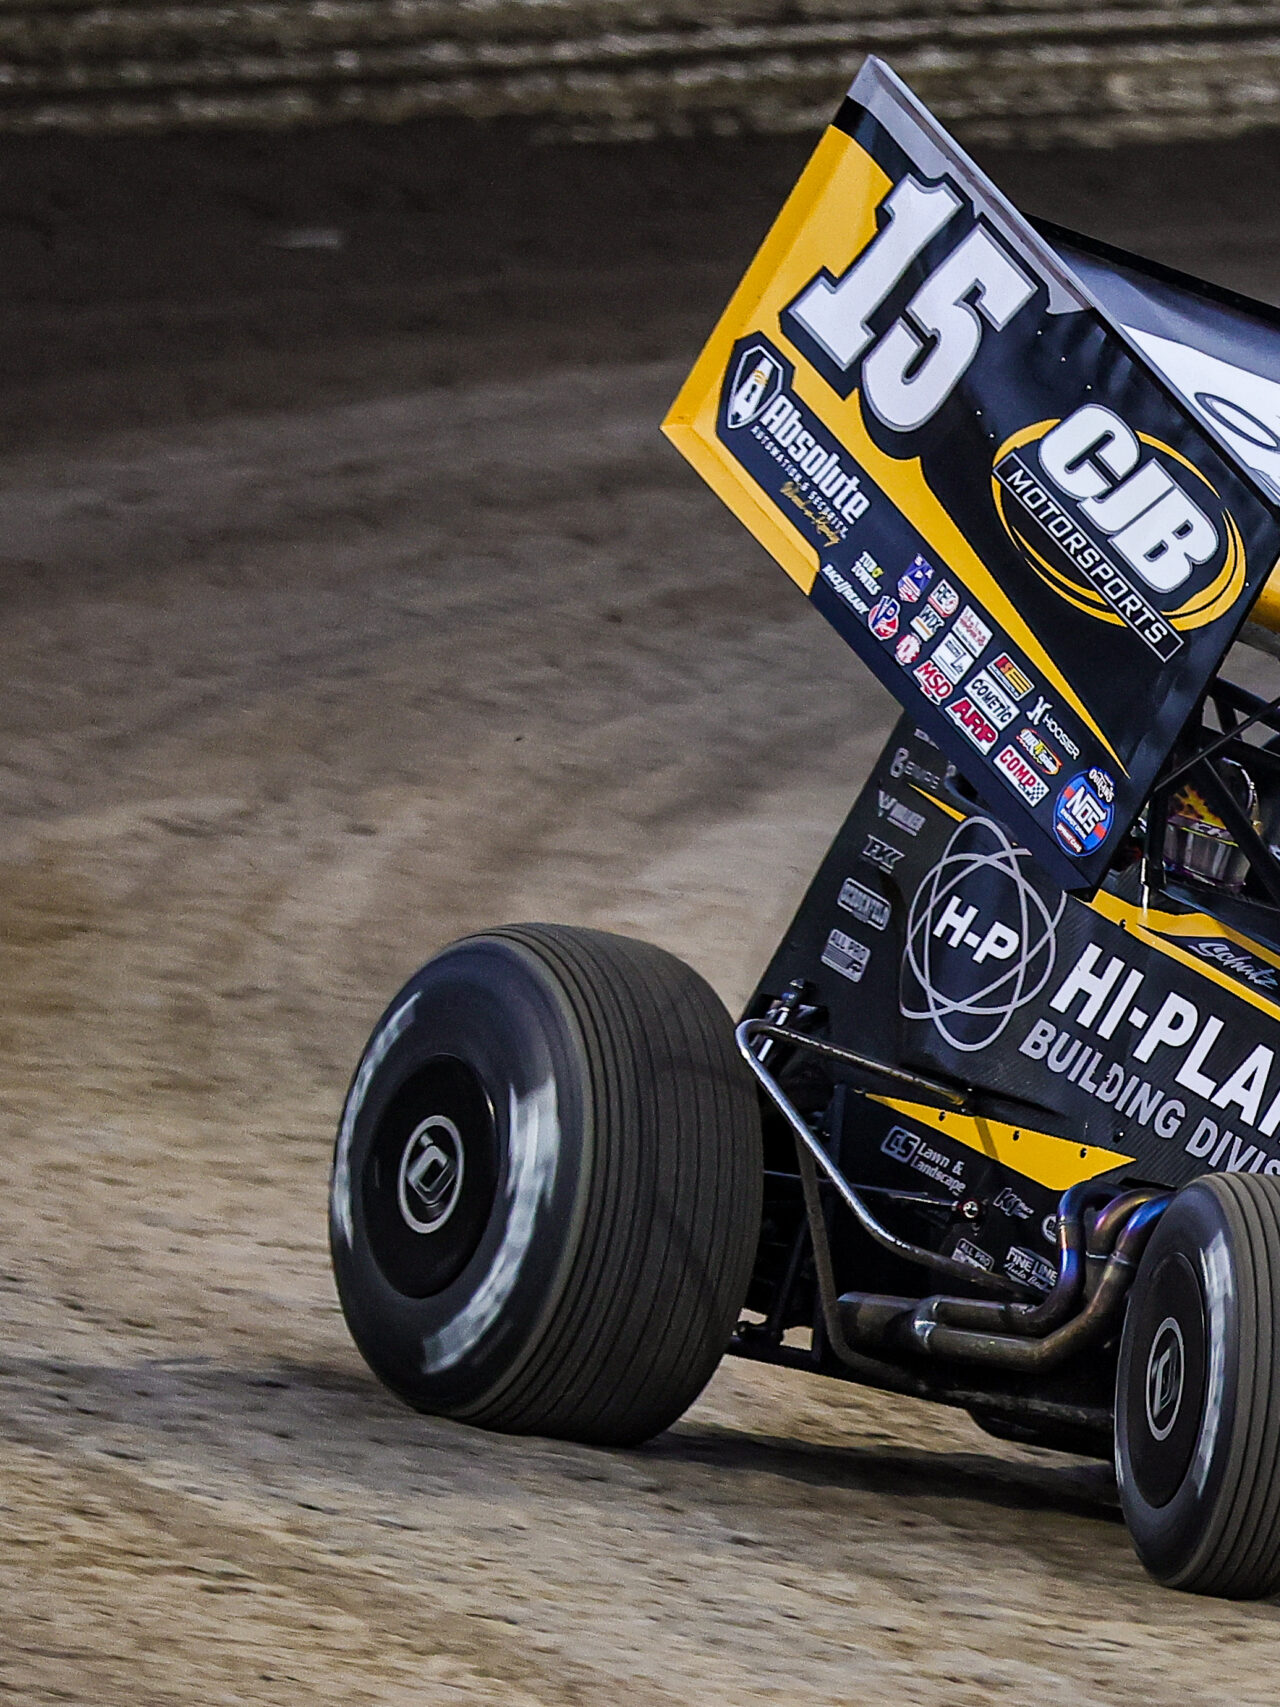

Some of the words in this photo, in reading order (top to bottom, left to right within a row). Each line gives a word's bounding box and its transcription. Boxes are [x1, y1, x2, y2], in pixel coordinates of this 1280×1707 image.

[787, 172, 1040, 433] 15
[759, 394, 871, 525] Absolute
[1036, 403, 1220, 594] CJB
[1005, 468, 1168, 644] MOTORSPORTS
[918, 606, 945, 632] WIX
[916, 660, 952, 701] MSD
[971, 677, 1013, 724] COMETIC
[951, 699, 998, 746] ARP
[1043, 713, 1080, 760] HOOSIER
[999, 749, 1036, 789] COMP
[1065, 788, 1107, 836] NOS
[932, 896, 1020, 963] H-P
[1019, 1017, 1185, 1140] BUILDING
[911, 1156, 966, 1192] Landscape
[917, 1142, 951, 1168] Lawn
[952, 1160, 965, 1176] &
